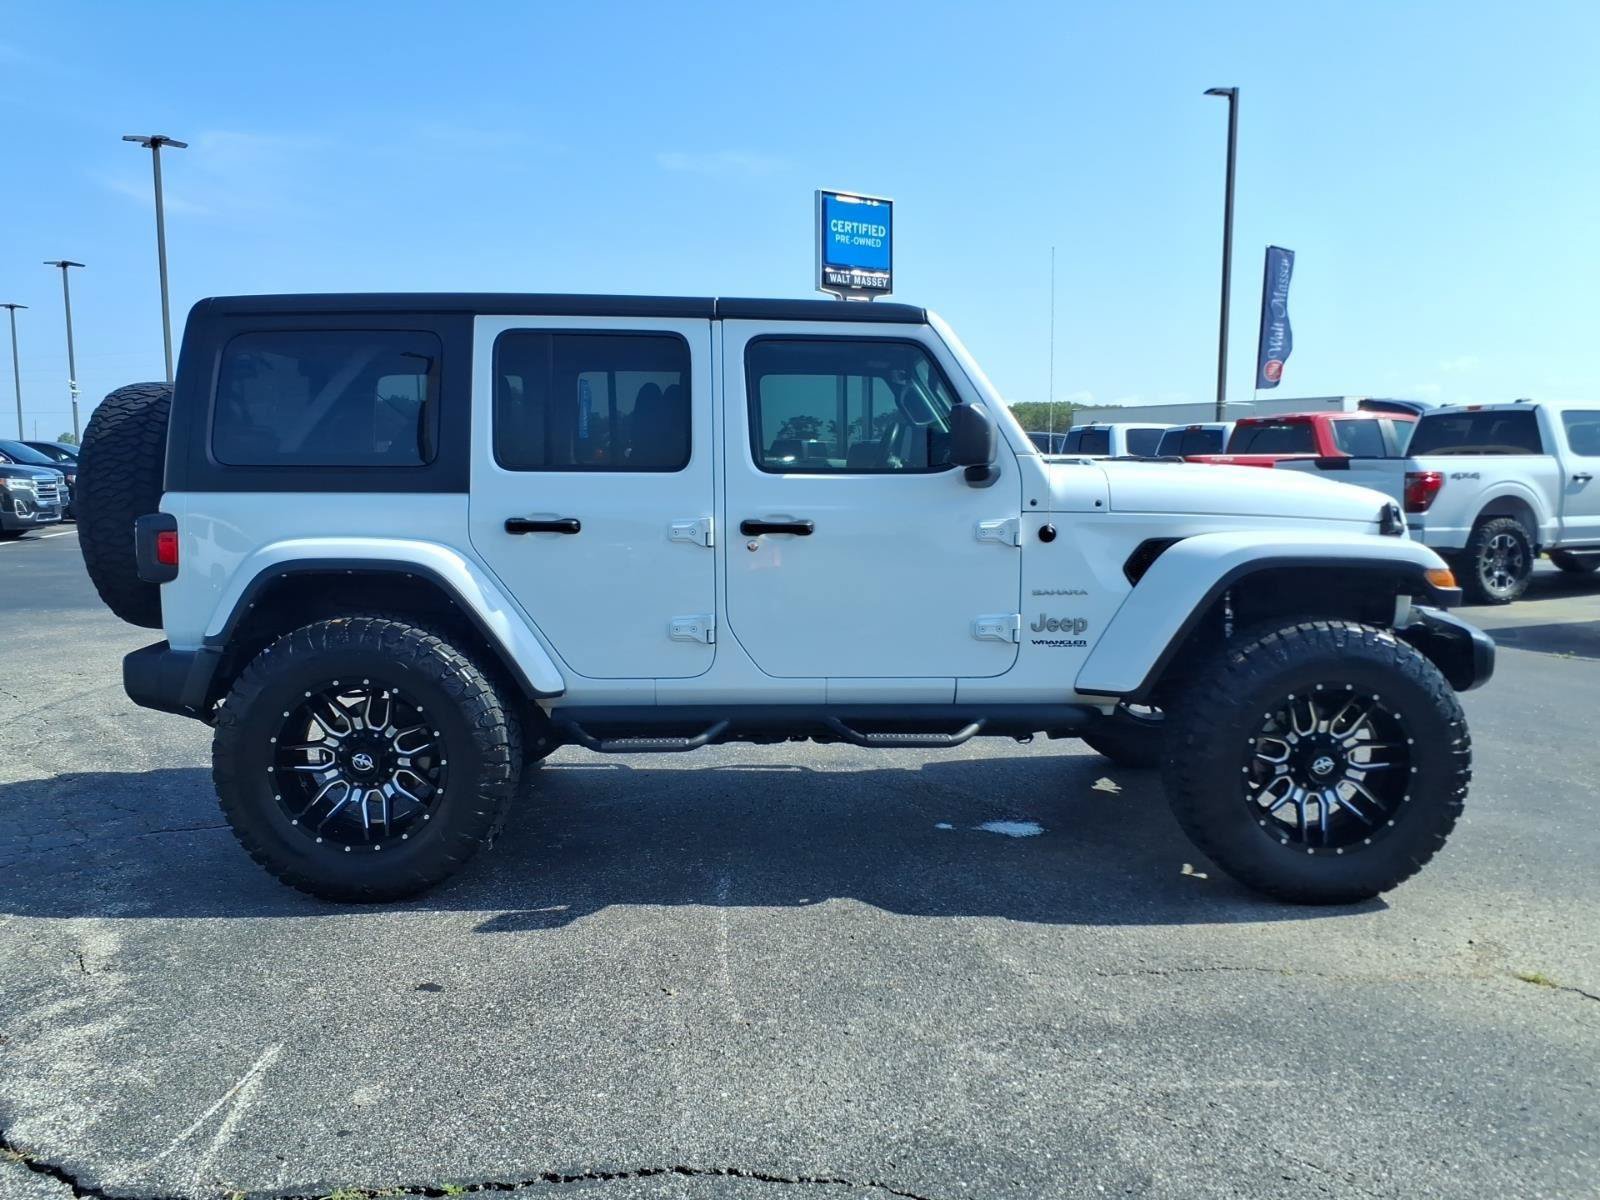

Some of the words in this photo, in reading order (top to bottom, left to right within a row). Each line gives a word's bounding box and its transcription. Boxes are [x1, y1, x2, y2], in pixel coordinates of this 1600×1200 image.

[830, 219, 887, 237] CERTIFIED
[835, 234, 882, 248] PRE-OWNED
[829, 273, 851, 283] WALT
[854, 275, 888, 287] MASSEY
[1267, 322, 1285, 359] Walt
[1031, 587, 1089, 596] SAHARA
[1030, 612, 1088, 635] Jeep
